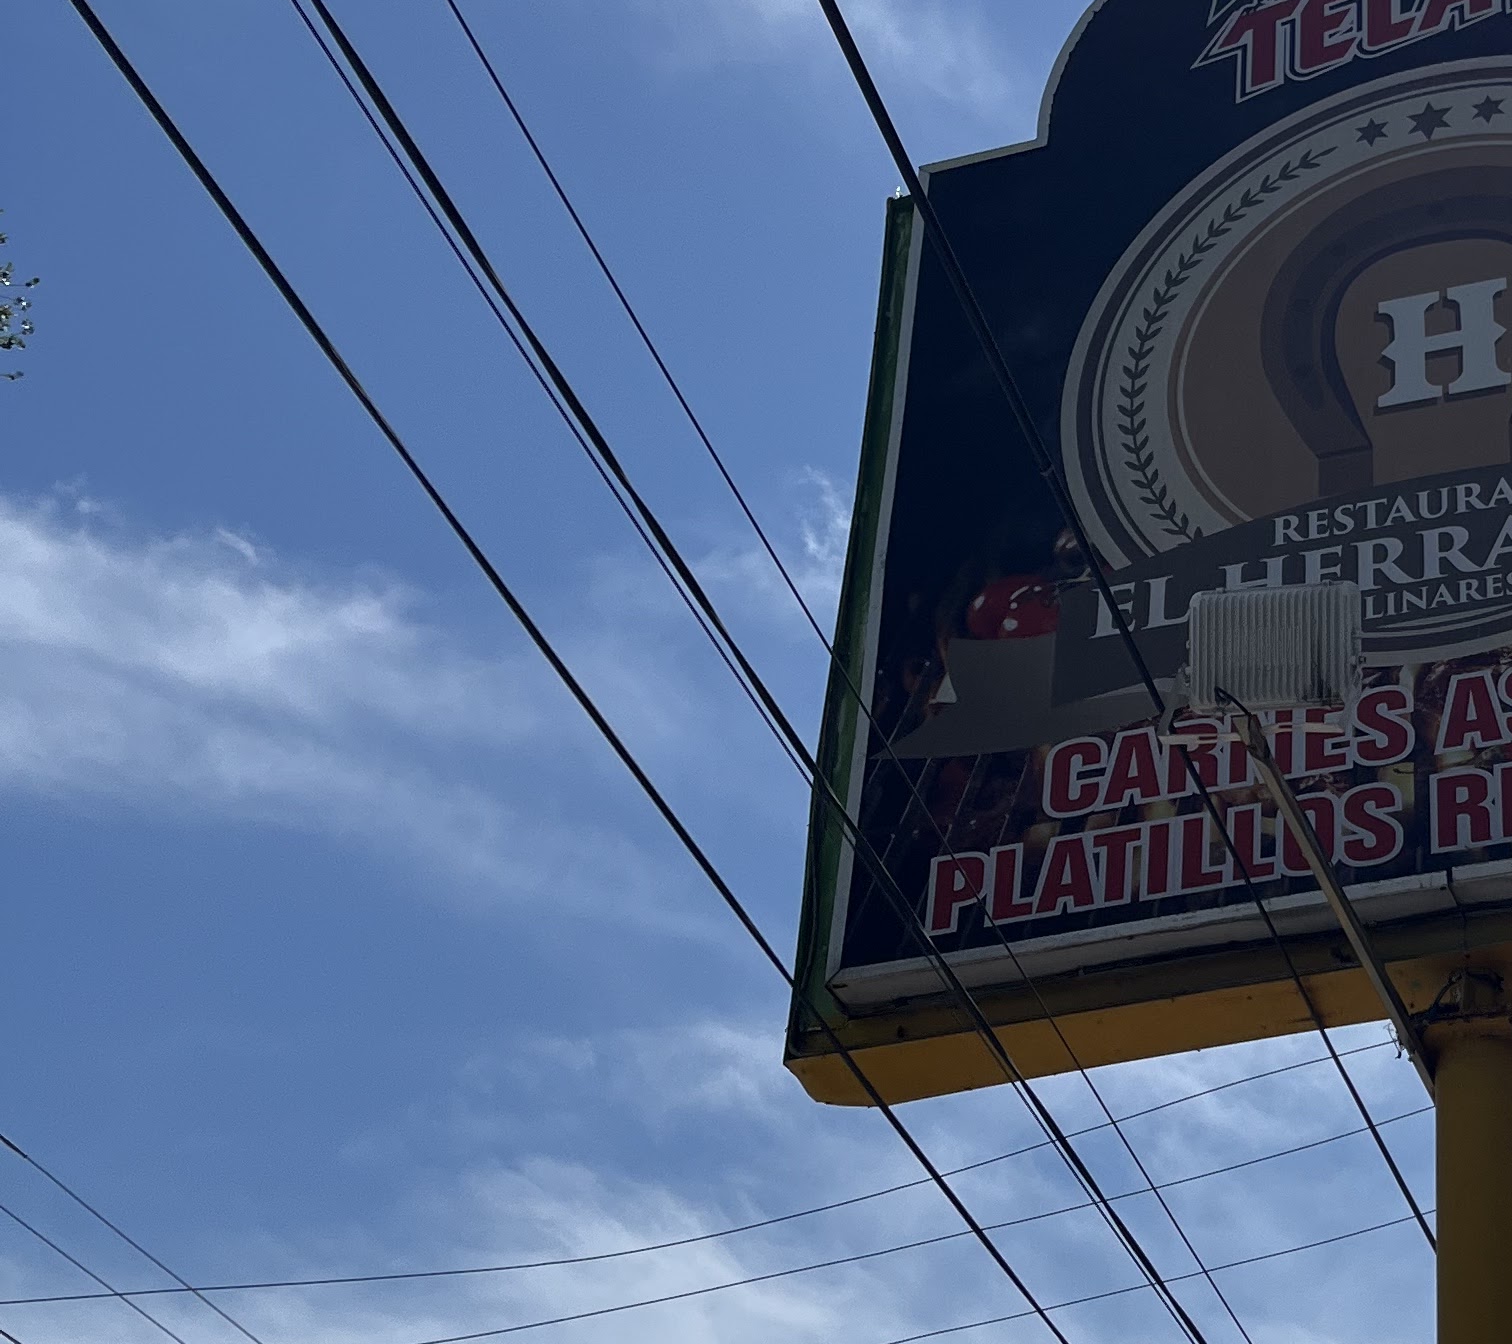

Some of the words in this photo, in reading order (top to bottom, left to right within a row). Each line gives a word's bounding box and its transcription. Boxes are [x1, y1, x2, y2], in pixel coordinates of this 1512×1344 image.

[1377, 277, 1512, 408] H
[1088, 574, 1191, 640] EL
[924, 783, 1404, 935] PLATILLOS
